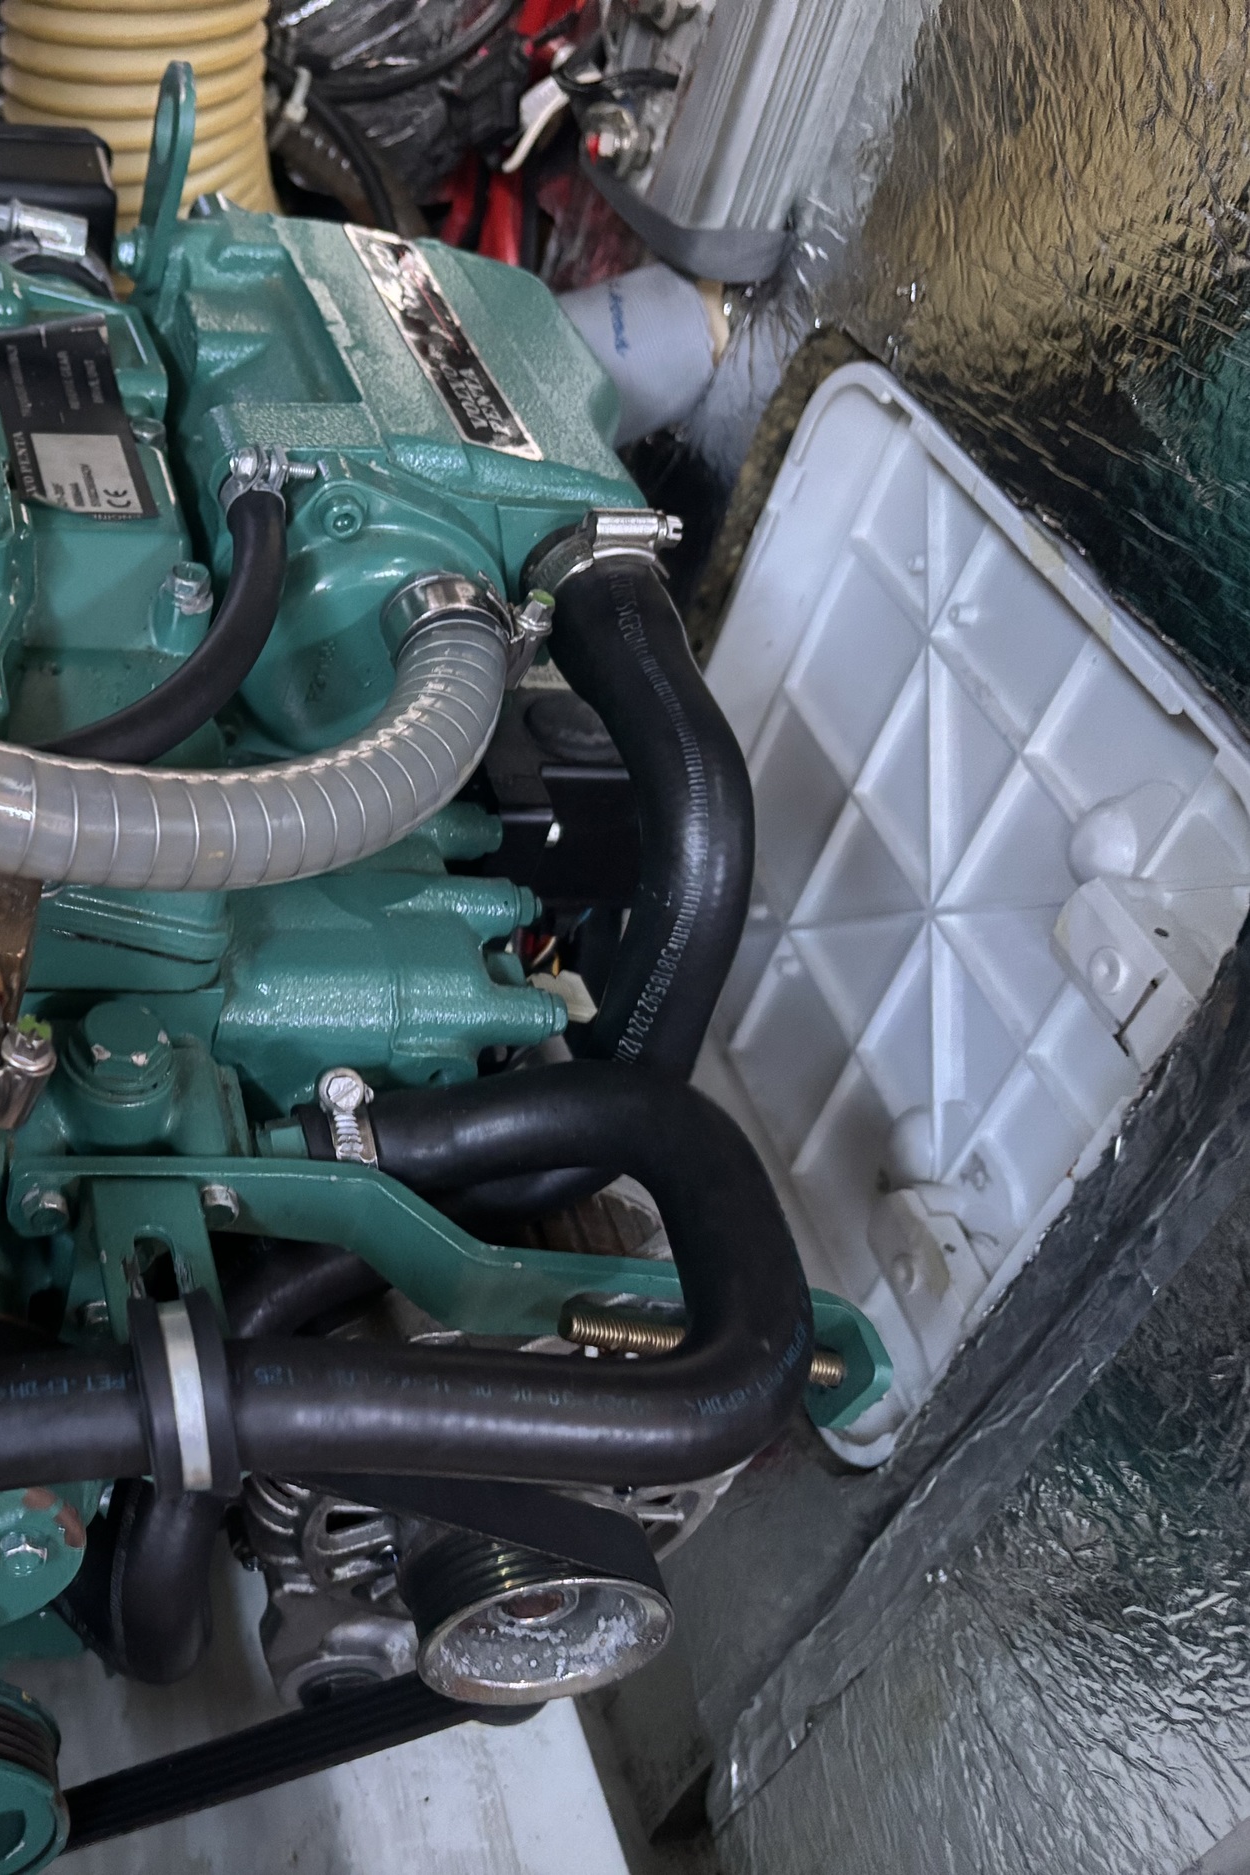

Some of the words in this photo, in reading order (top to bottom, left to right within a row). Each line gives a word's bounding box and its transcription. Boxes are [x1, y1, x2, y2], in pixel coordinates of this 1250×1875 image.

[437, 364, 489, 429] VOLVO
[457, 366, 512, 435] PENTA
[11, 431, 32, 475] PENTA
